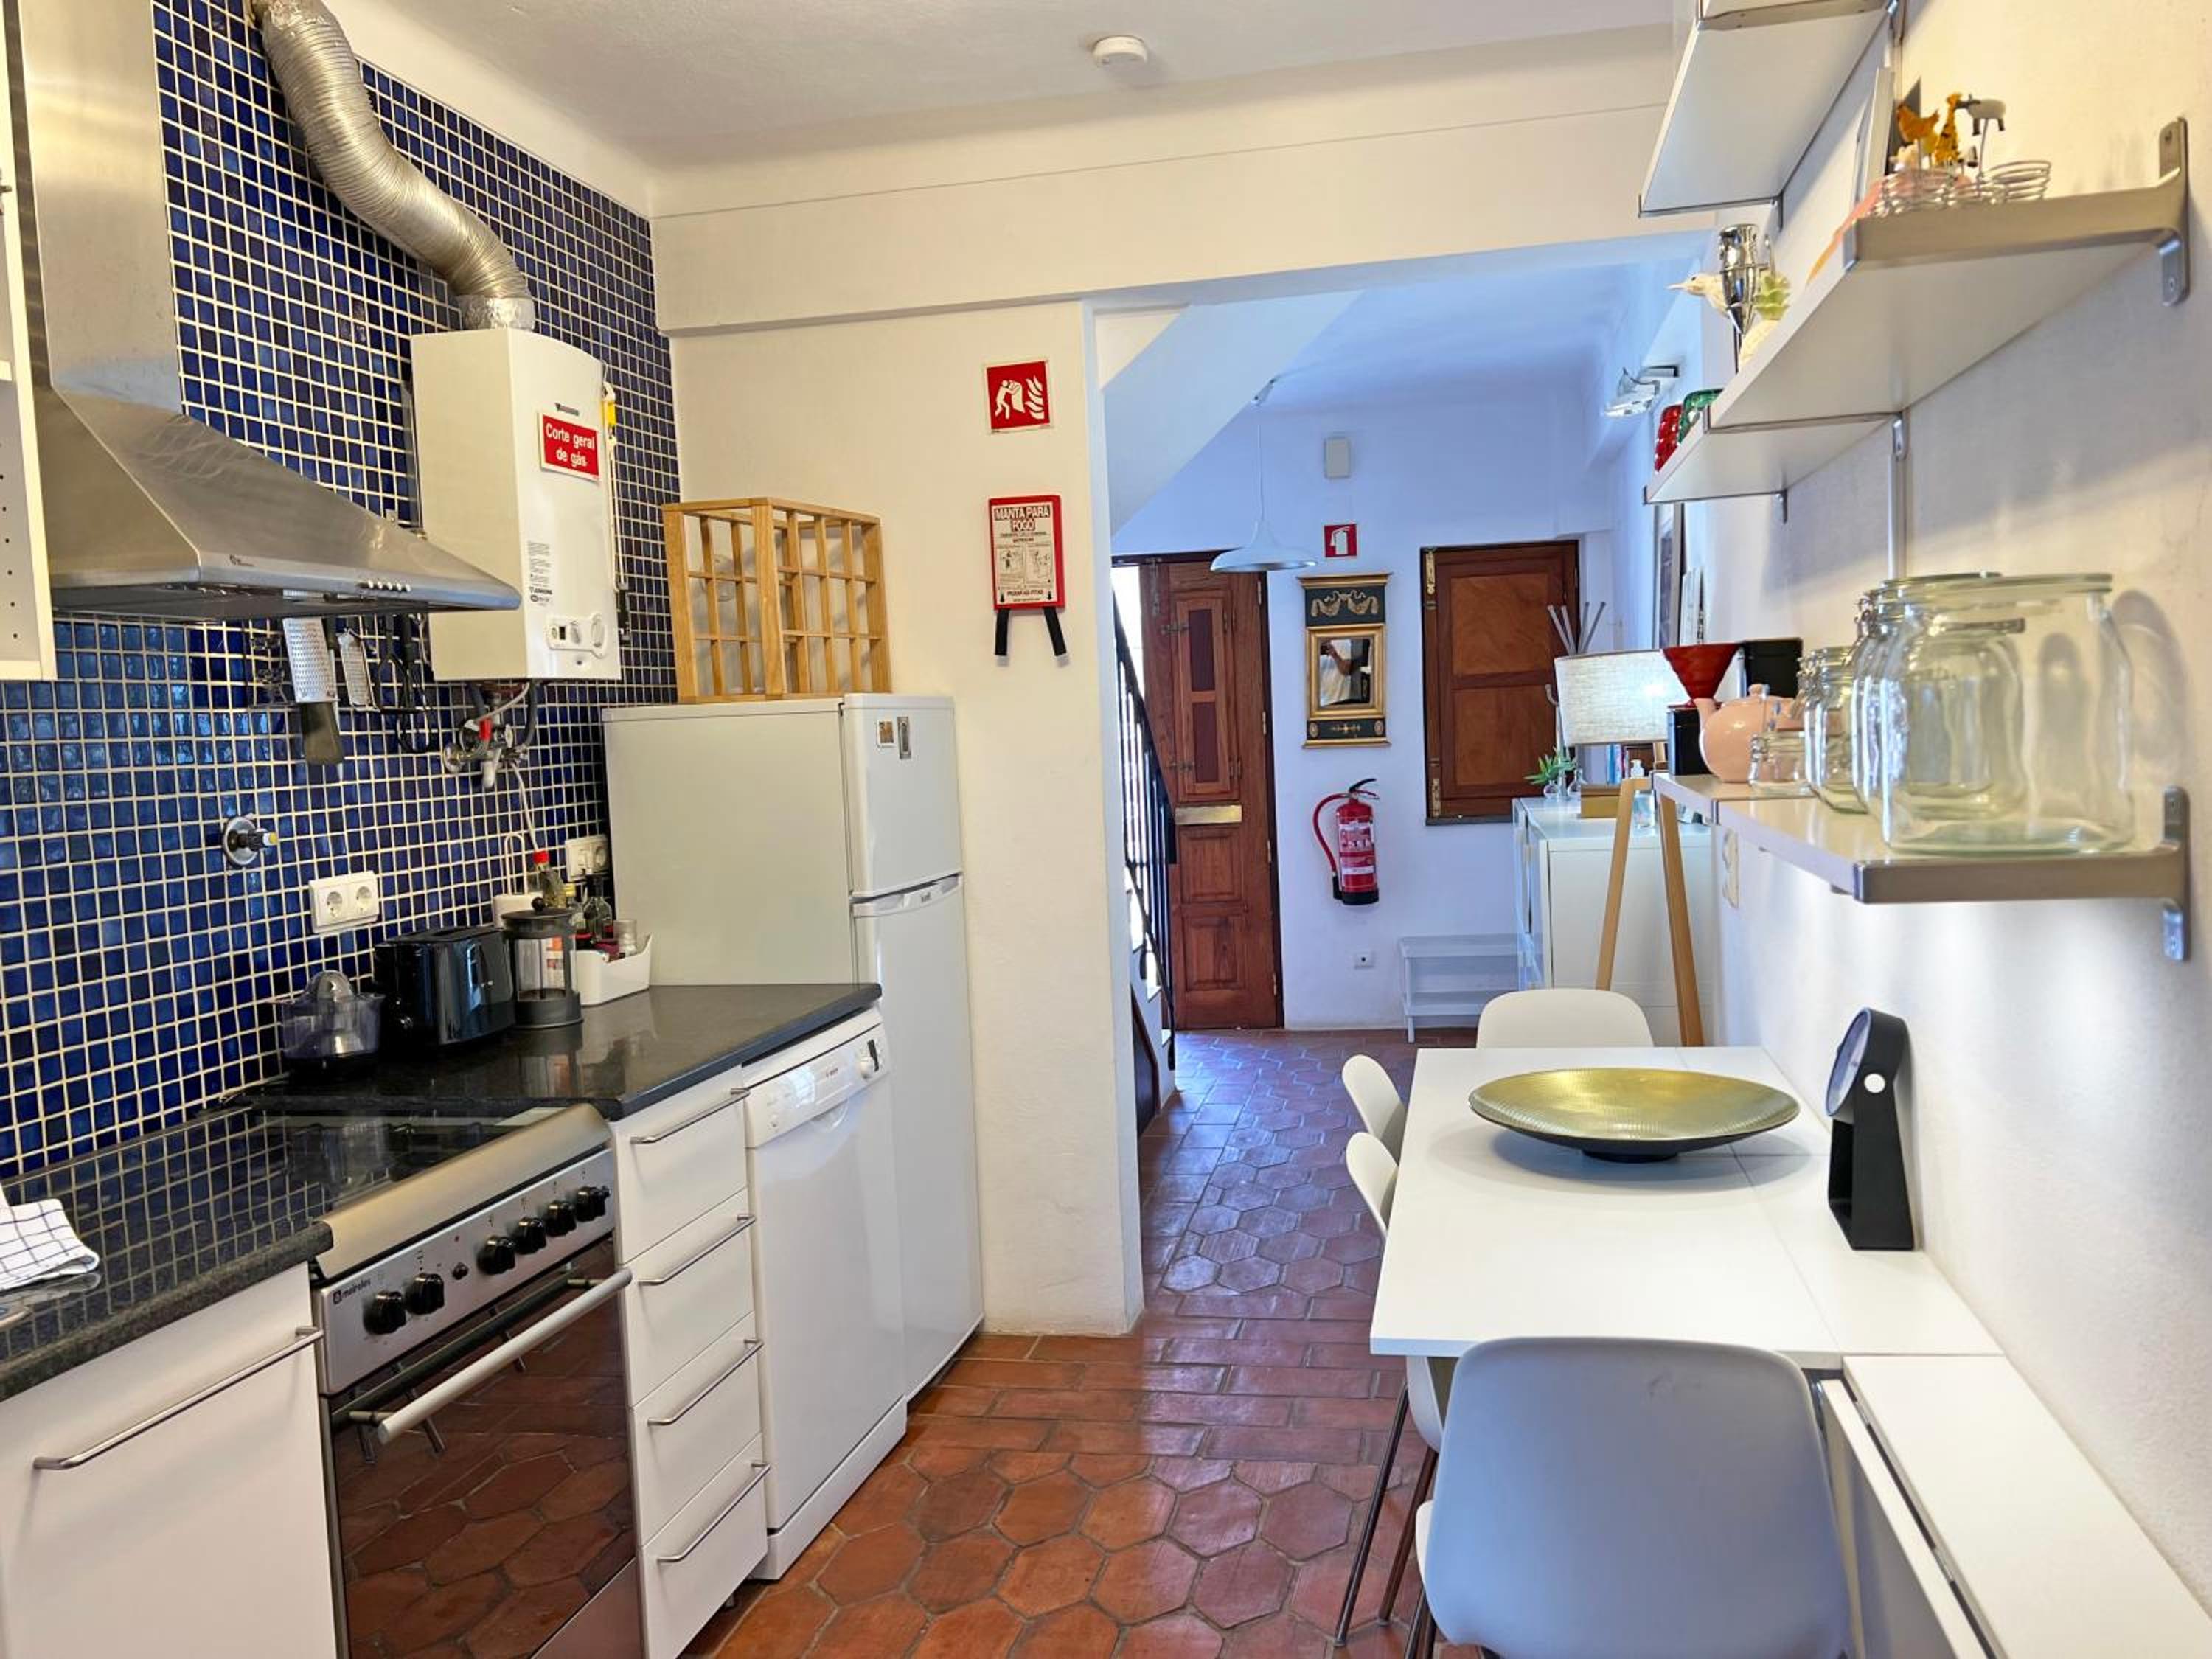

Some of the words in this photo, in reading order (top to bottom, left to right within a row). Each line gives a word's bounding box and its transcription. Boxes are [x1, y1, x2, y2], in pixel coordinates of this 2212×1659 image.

[546, 422, 570, 442] Corte
[573, 434, 595, 450] geral
[555, 446, 568, 462] de
[570, 451, 588, 467] gás
[995, 507, 1026, 520] MANTA
[1026, 505, 1049, 518] PARA
[1012, 519, 1035, 531] FOGO
